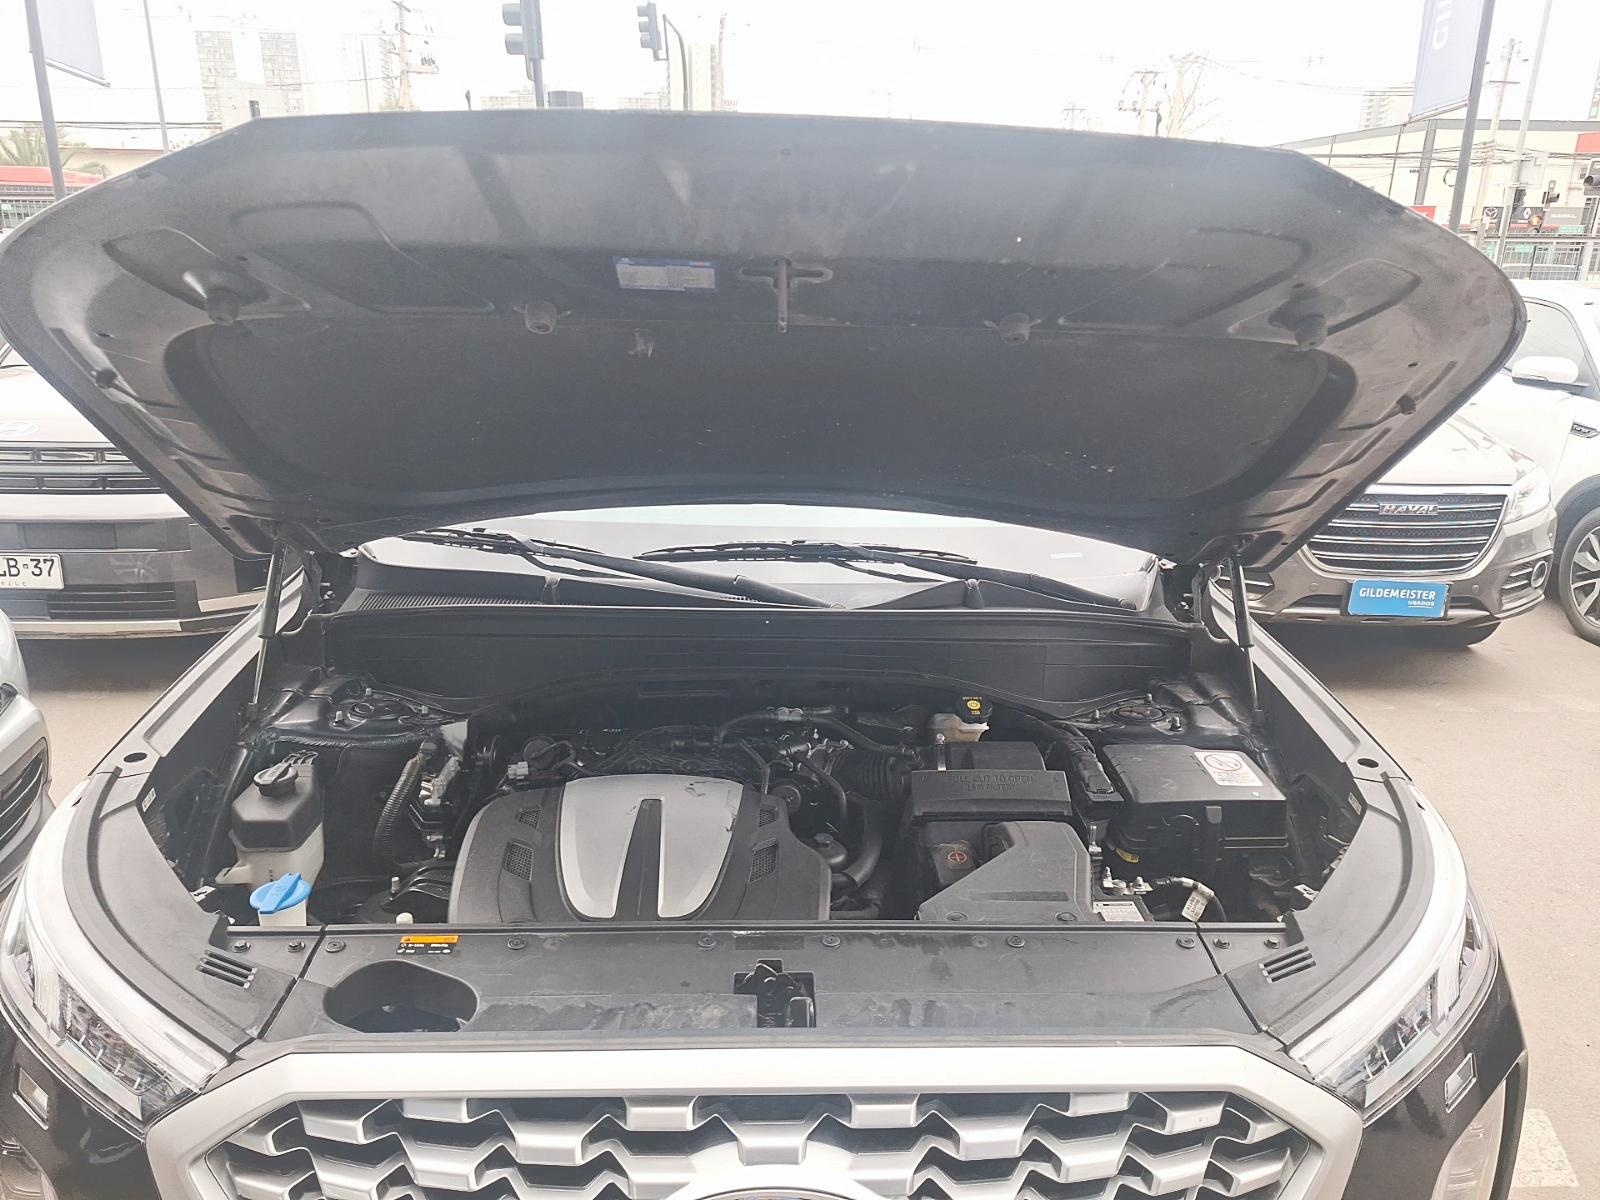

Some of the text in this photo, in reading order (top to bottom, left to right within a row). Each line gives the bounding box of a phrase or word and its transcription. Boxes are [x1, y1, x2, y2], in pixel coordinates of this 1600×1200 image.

[1380, 504, 1438, 515] HAVAL
[1360, 588, 1436, 600] GILDEMEISTER
[994, 775, 1006, 783] TO
[1008, 774, 1033, 783] OPEN
